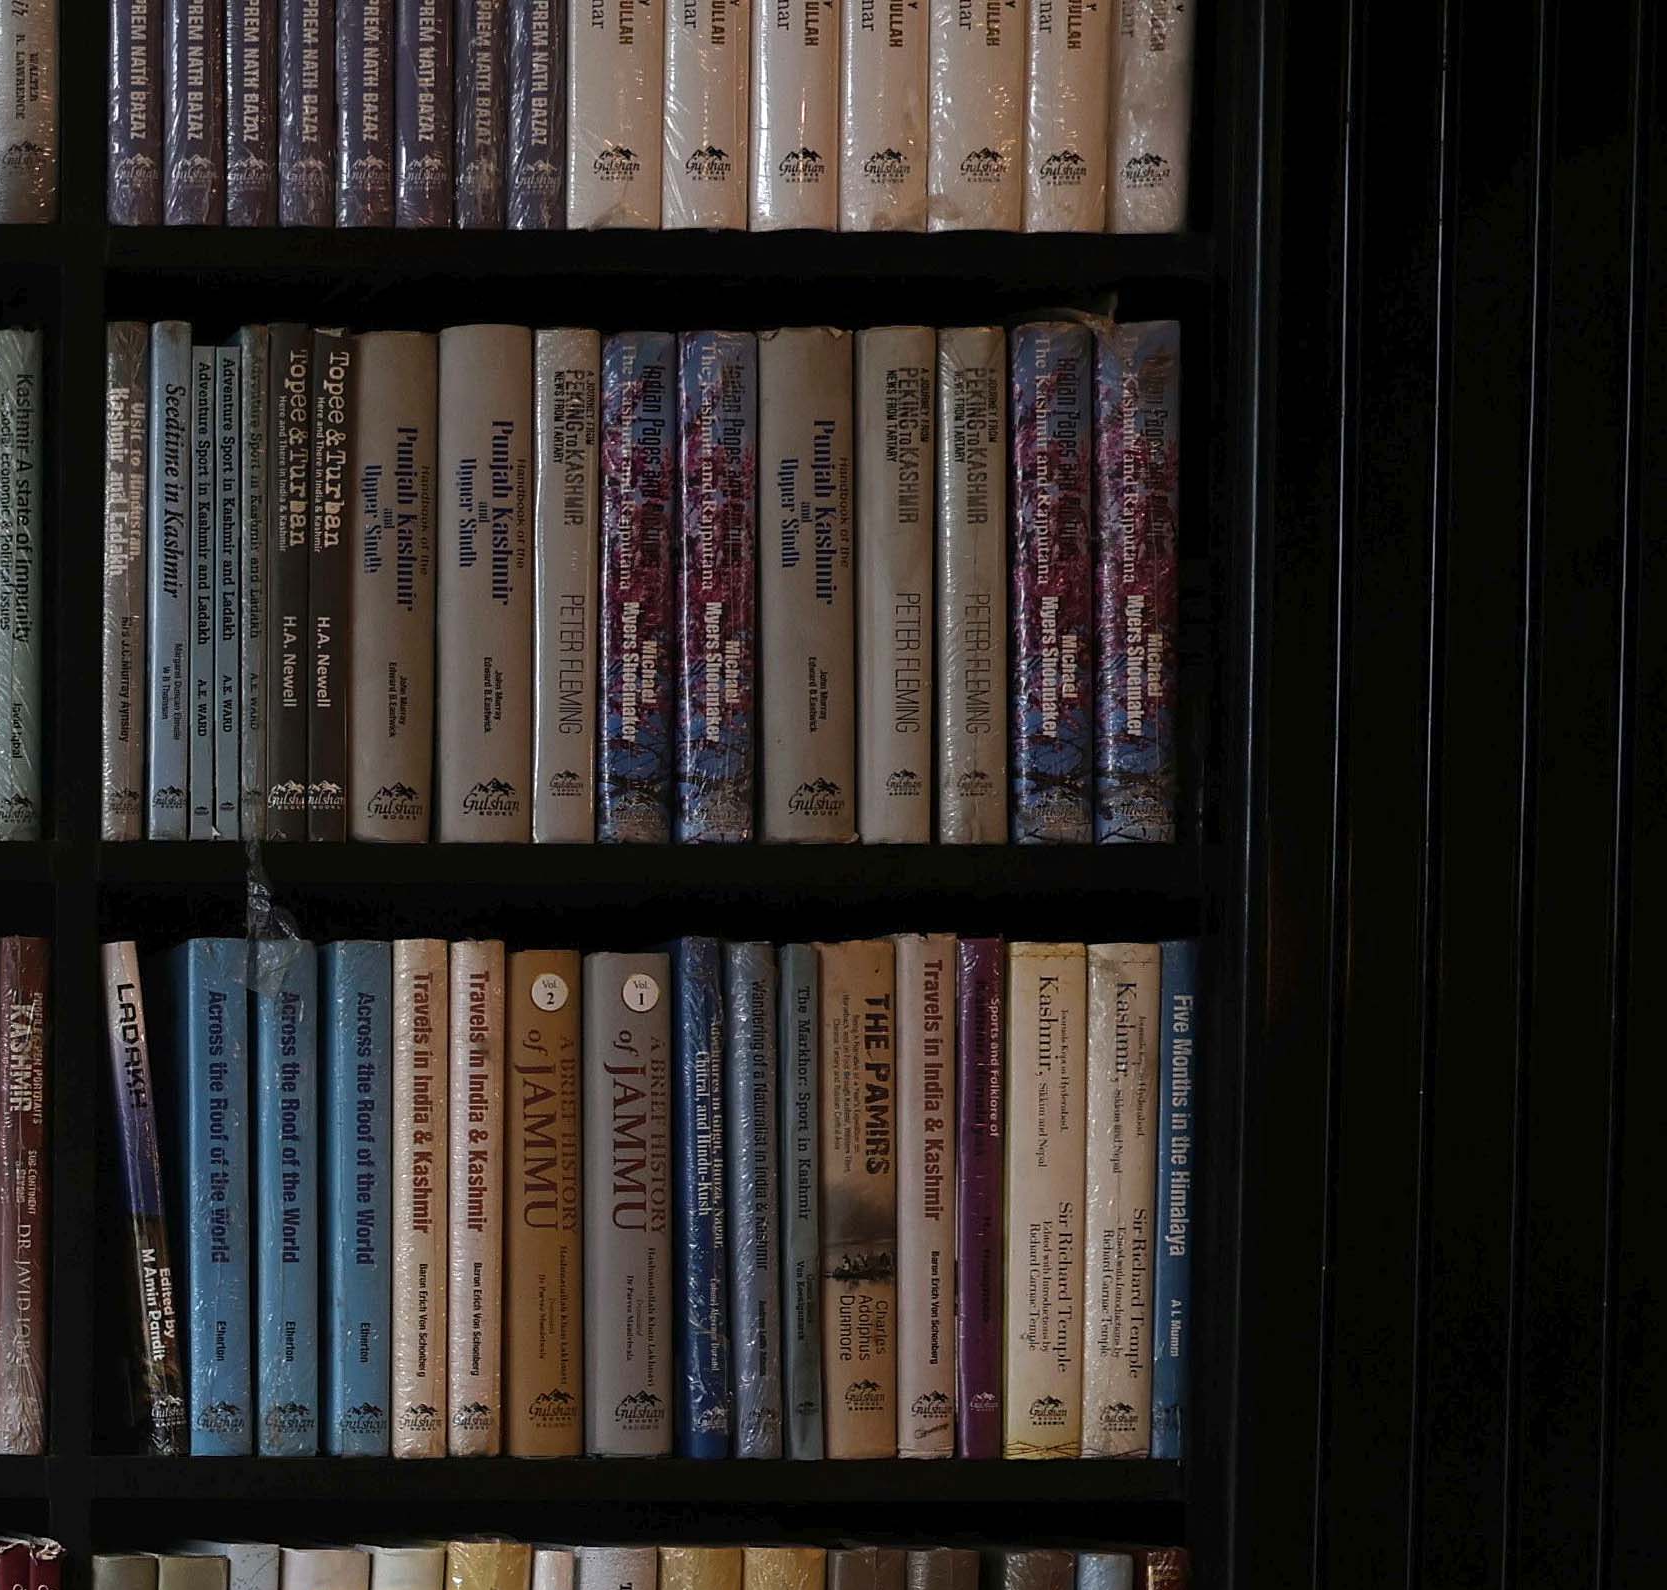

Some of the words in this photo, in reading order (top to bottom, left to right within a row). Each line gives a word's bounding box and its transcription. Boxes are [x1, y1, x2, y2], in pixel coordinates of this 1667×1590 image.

[531, 51, 548, 92] NATH
[530, 97, 547, 145] BAZAZ
[324, 351, 349, 424] Topee
[326, 429, 345, 447] &
[324, 451, 346, 547] Turban
[317, 617, 329, 648] H.A.
[559, 595, 584, 651] PETER
[316, 654, 330, 707] Newell
[559, 659, 582, 734] FLEMING
[355, 992, 375, 1057] Across
[864, 994, 891, 1056] THE
[1173, 995, 1193, 1033] Five
[356, 1064, 375, 1093] the
[1172, 1038, 1191, 1108] Months
[356, 1099, 374, 1142] Roof
[864, 1062, 891, 1175] PAMIRS
[1171, 1113, 1191, 1130] in
[355, 1149, 373, 1168] of
[1171, 1136, 1191, 1166] the
[356, 1173, 373, 1203] the
[355, 1209, 374, 1264] World
[1165, 1171, 1190, 1256] Himalaya
[358, 1322, 371, 1363] Etherton
